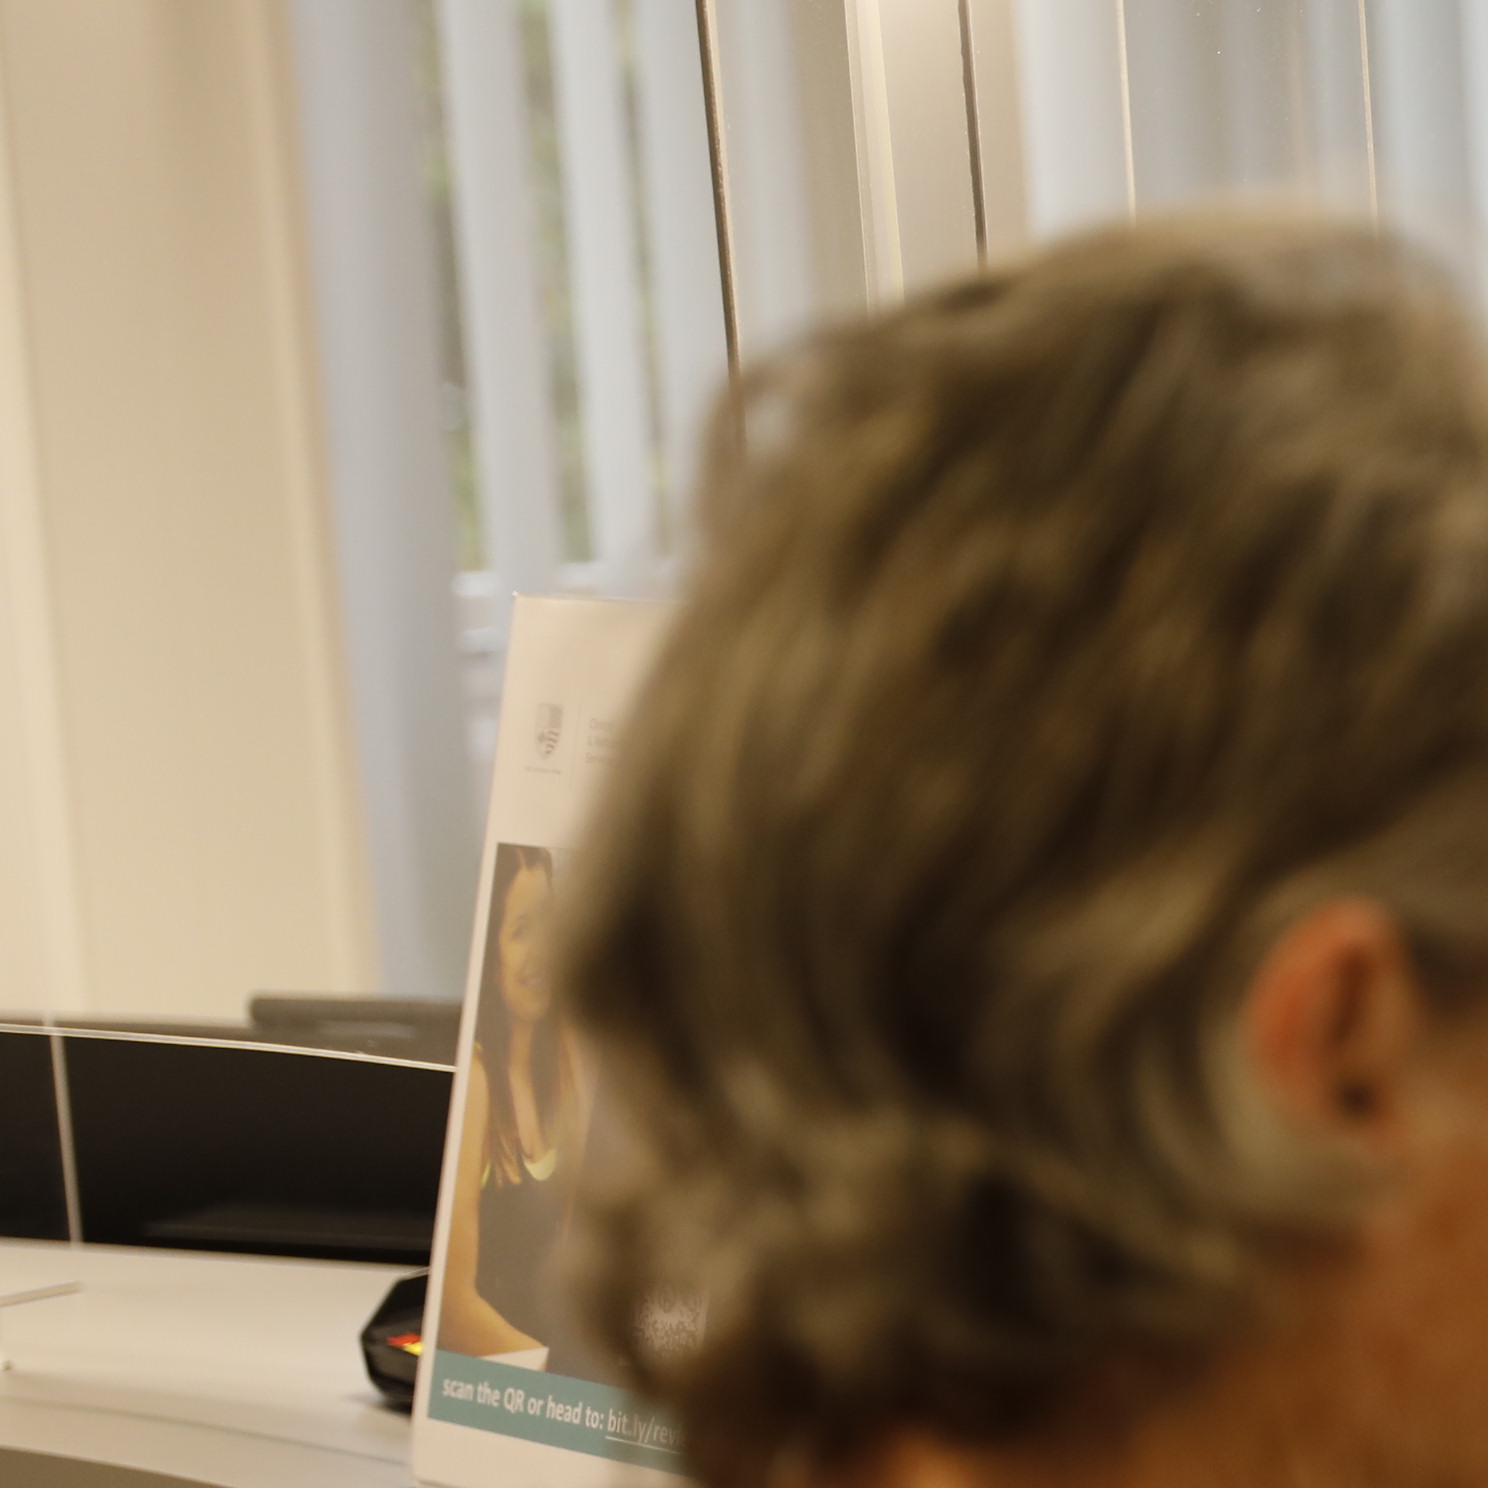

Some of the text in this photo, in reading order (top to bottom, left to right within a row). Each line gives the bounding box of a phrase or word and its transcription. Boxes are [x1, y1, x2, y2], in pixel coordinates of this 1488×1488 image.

[442, 1378, 473, 1400] scan
[477, 1381, 500, 1406] the
[503, 1387, 524, 1413] QR
[527, 1397, 544, 1415] or
[546, 1394, 582, 1425] head
[585, 1405, 604, 1430] to:
